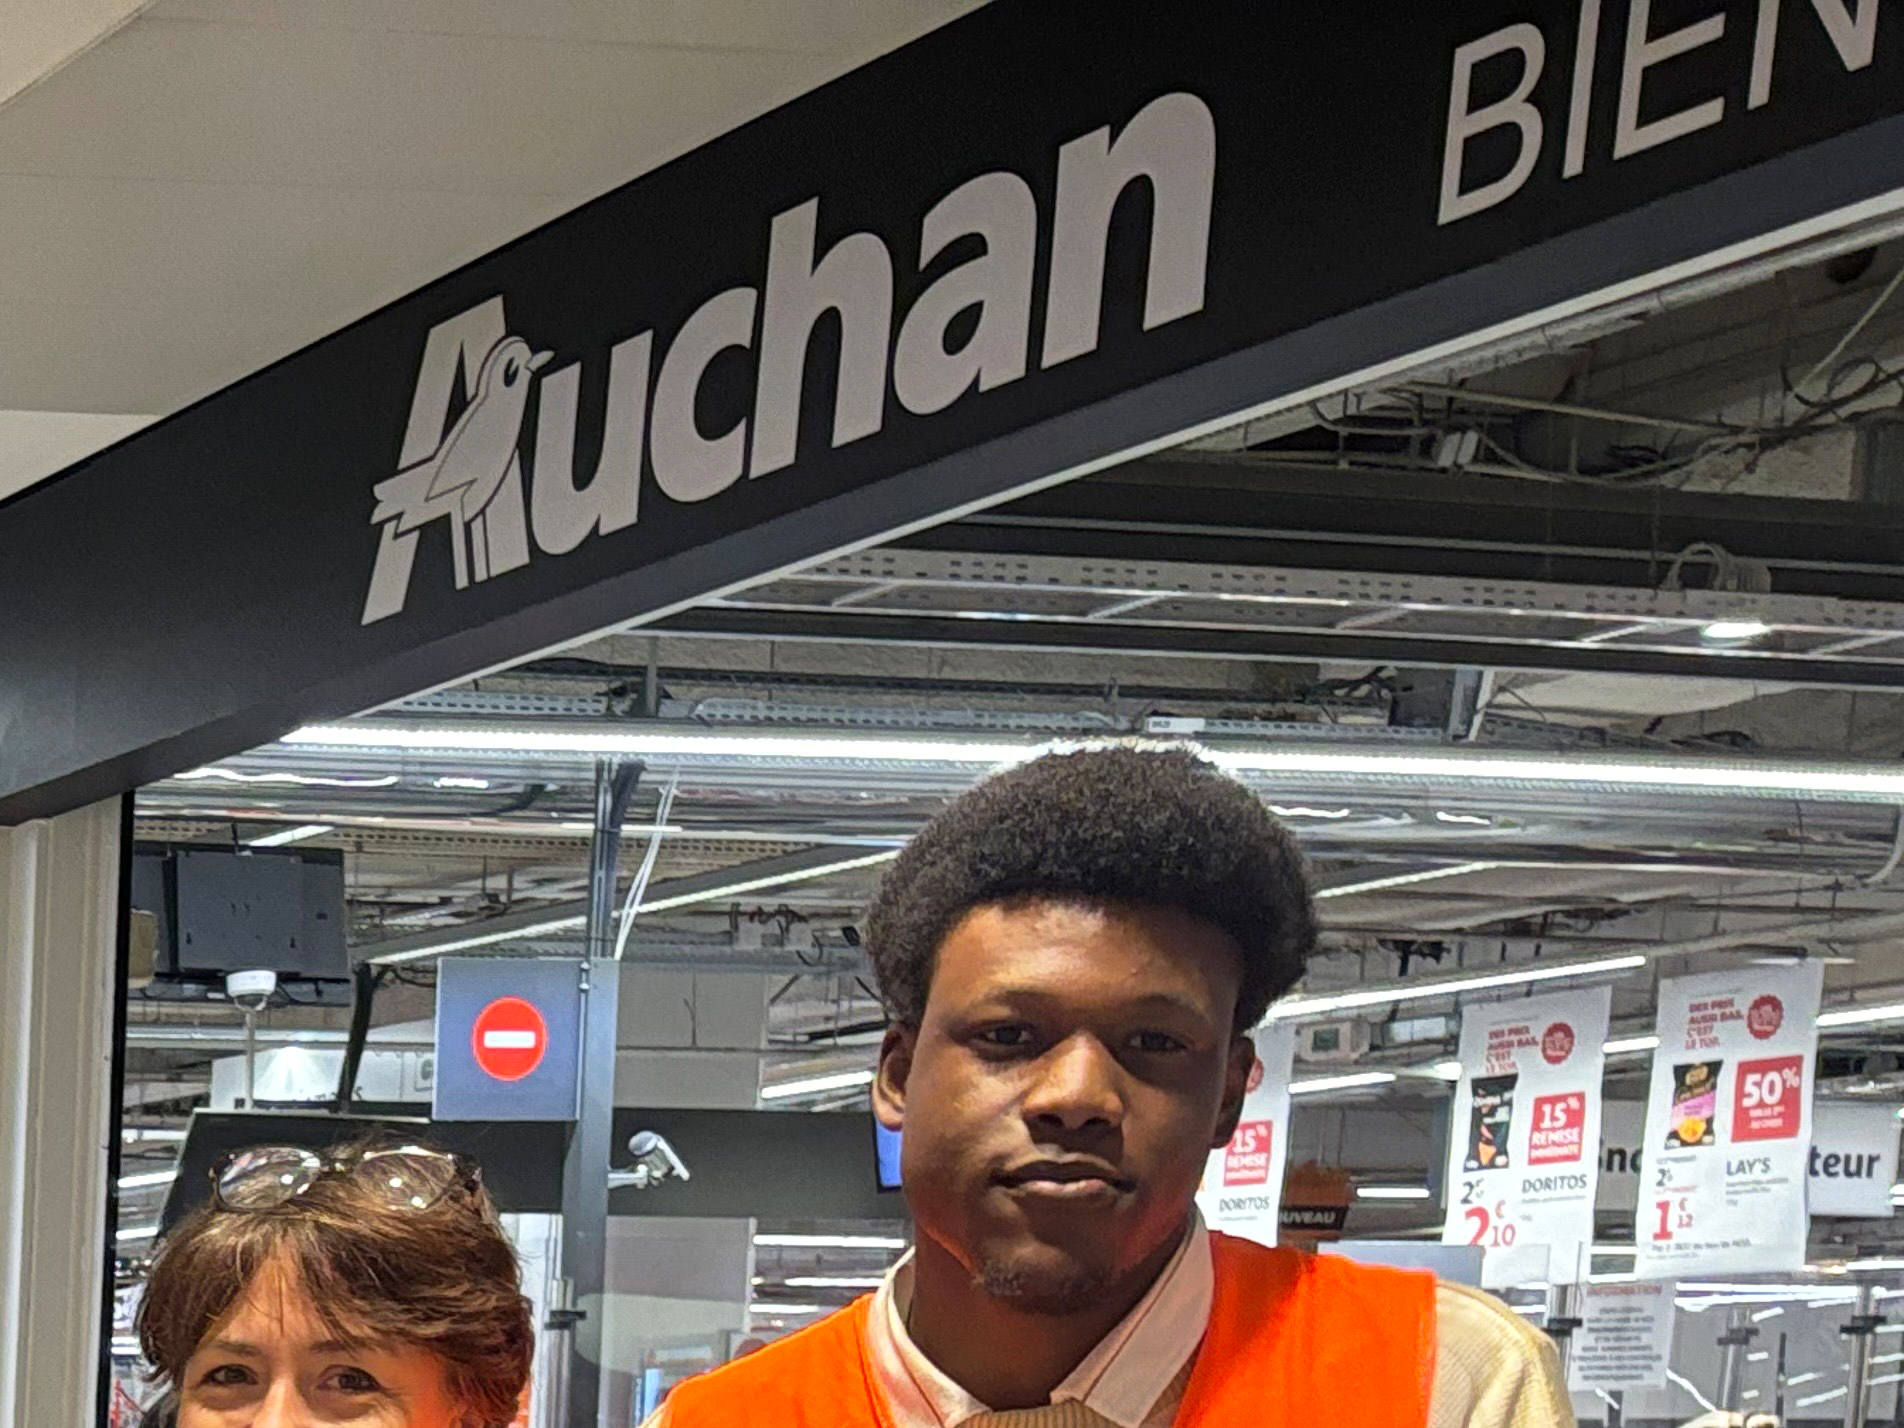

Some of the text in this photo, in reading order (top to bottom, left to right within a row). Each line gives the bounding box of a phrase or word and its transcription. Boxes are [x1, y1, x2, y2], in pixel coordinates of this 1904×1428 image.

[358, 91, 1217, 625] Auchan
[1742, 1066, 1800, 1107] 50%
[1726, 1157, 1772, 1177] LAY'S
[1521, 1173, 1588, 1194] DORITOS
